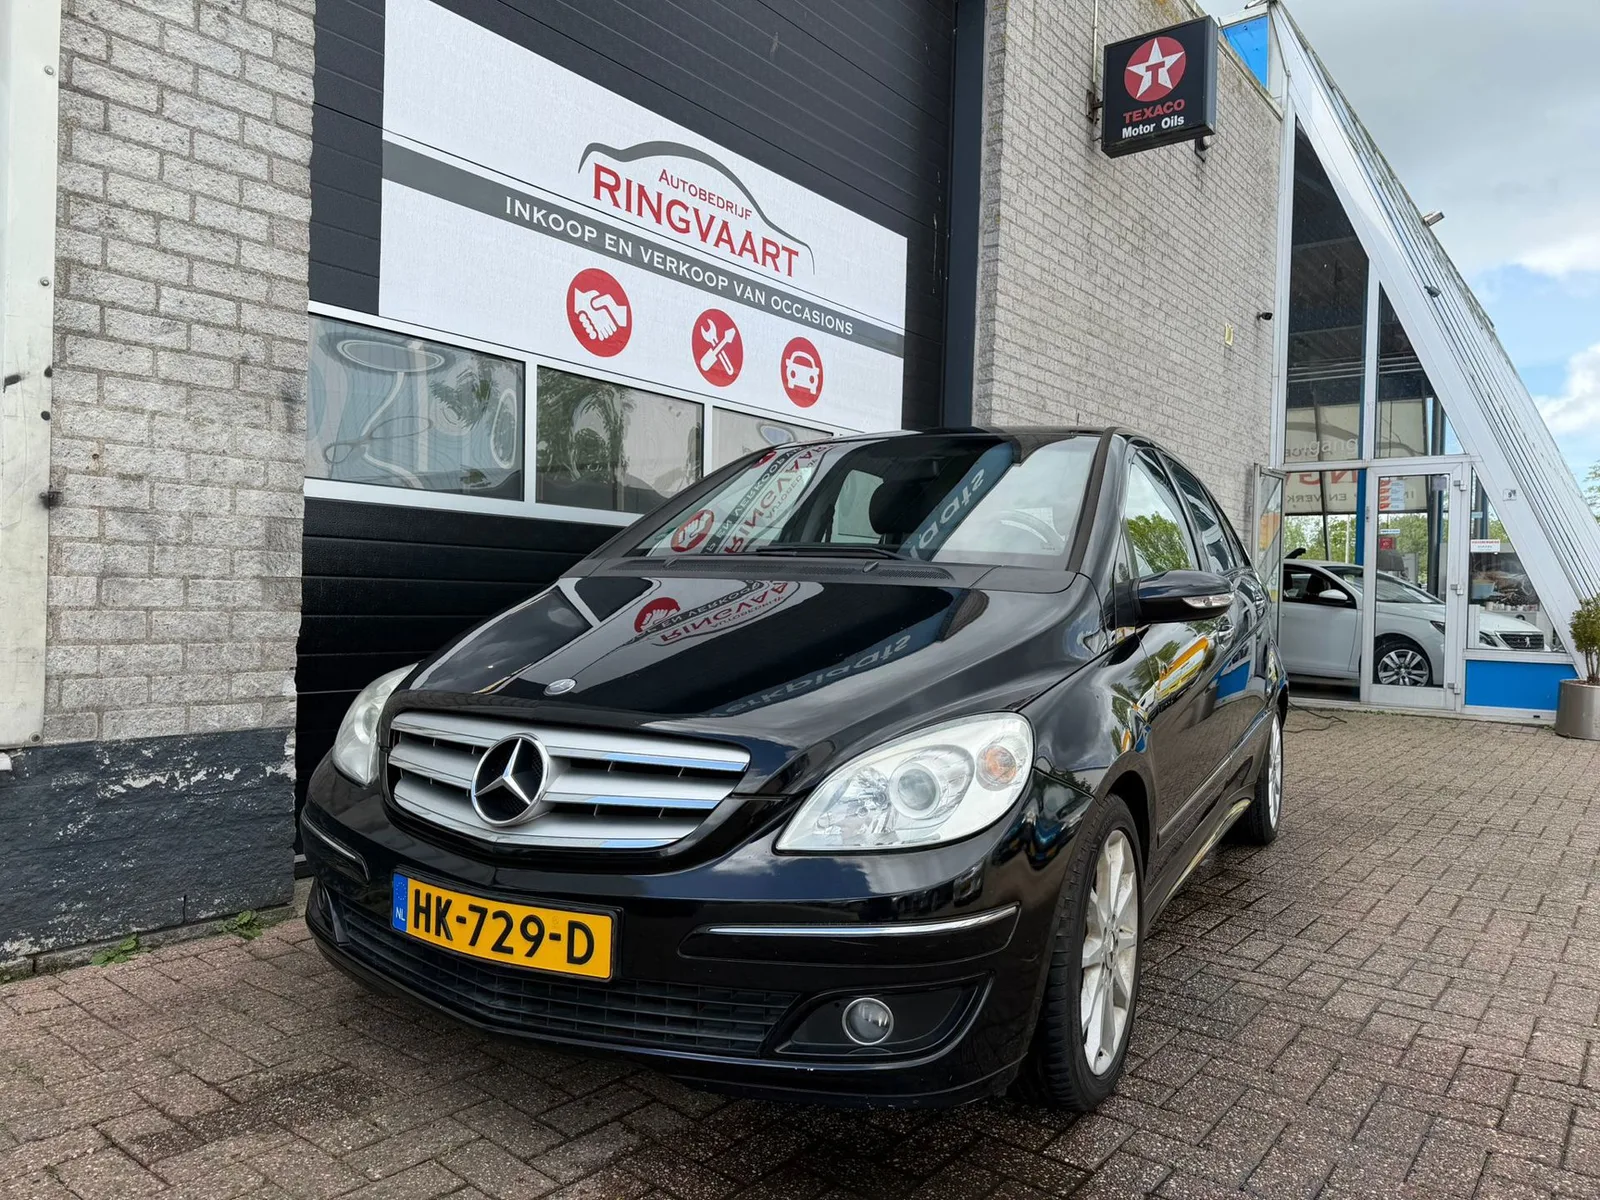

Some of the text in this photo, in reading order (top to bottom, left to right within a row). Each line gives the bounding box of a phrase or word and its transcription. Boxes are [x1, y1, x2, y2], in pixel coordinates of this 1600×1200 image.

[1122, 115, 1184, 139] Motor Oils
[1123, 99, 1185, 124] TEXACO
[593, 163, 799, 277] RINGVAART
[506, 196, 853, 336] INKOOP EN VERKOOP VAN OCCASIONS
[396, 906, 405, 922] NL
[414, 889, 594, 965] HK-729-D
